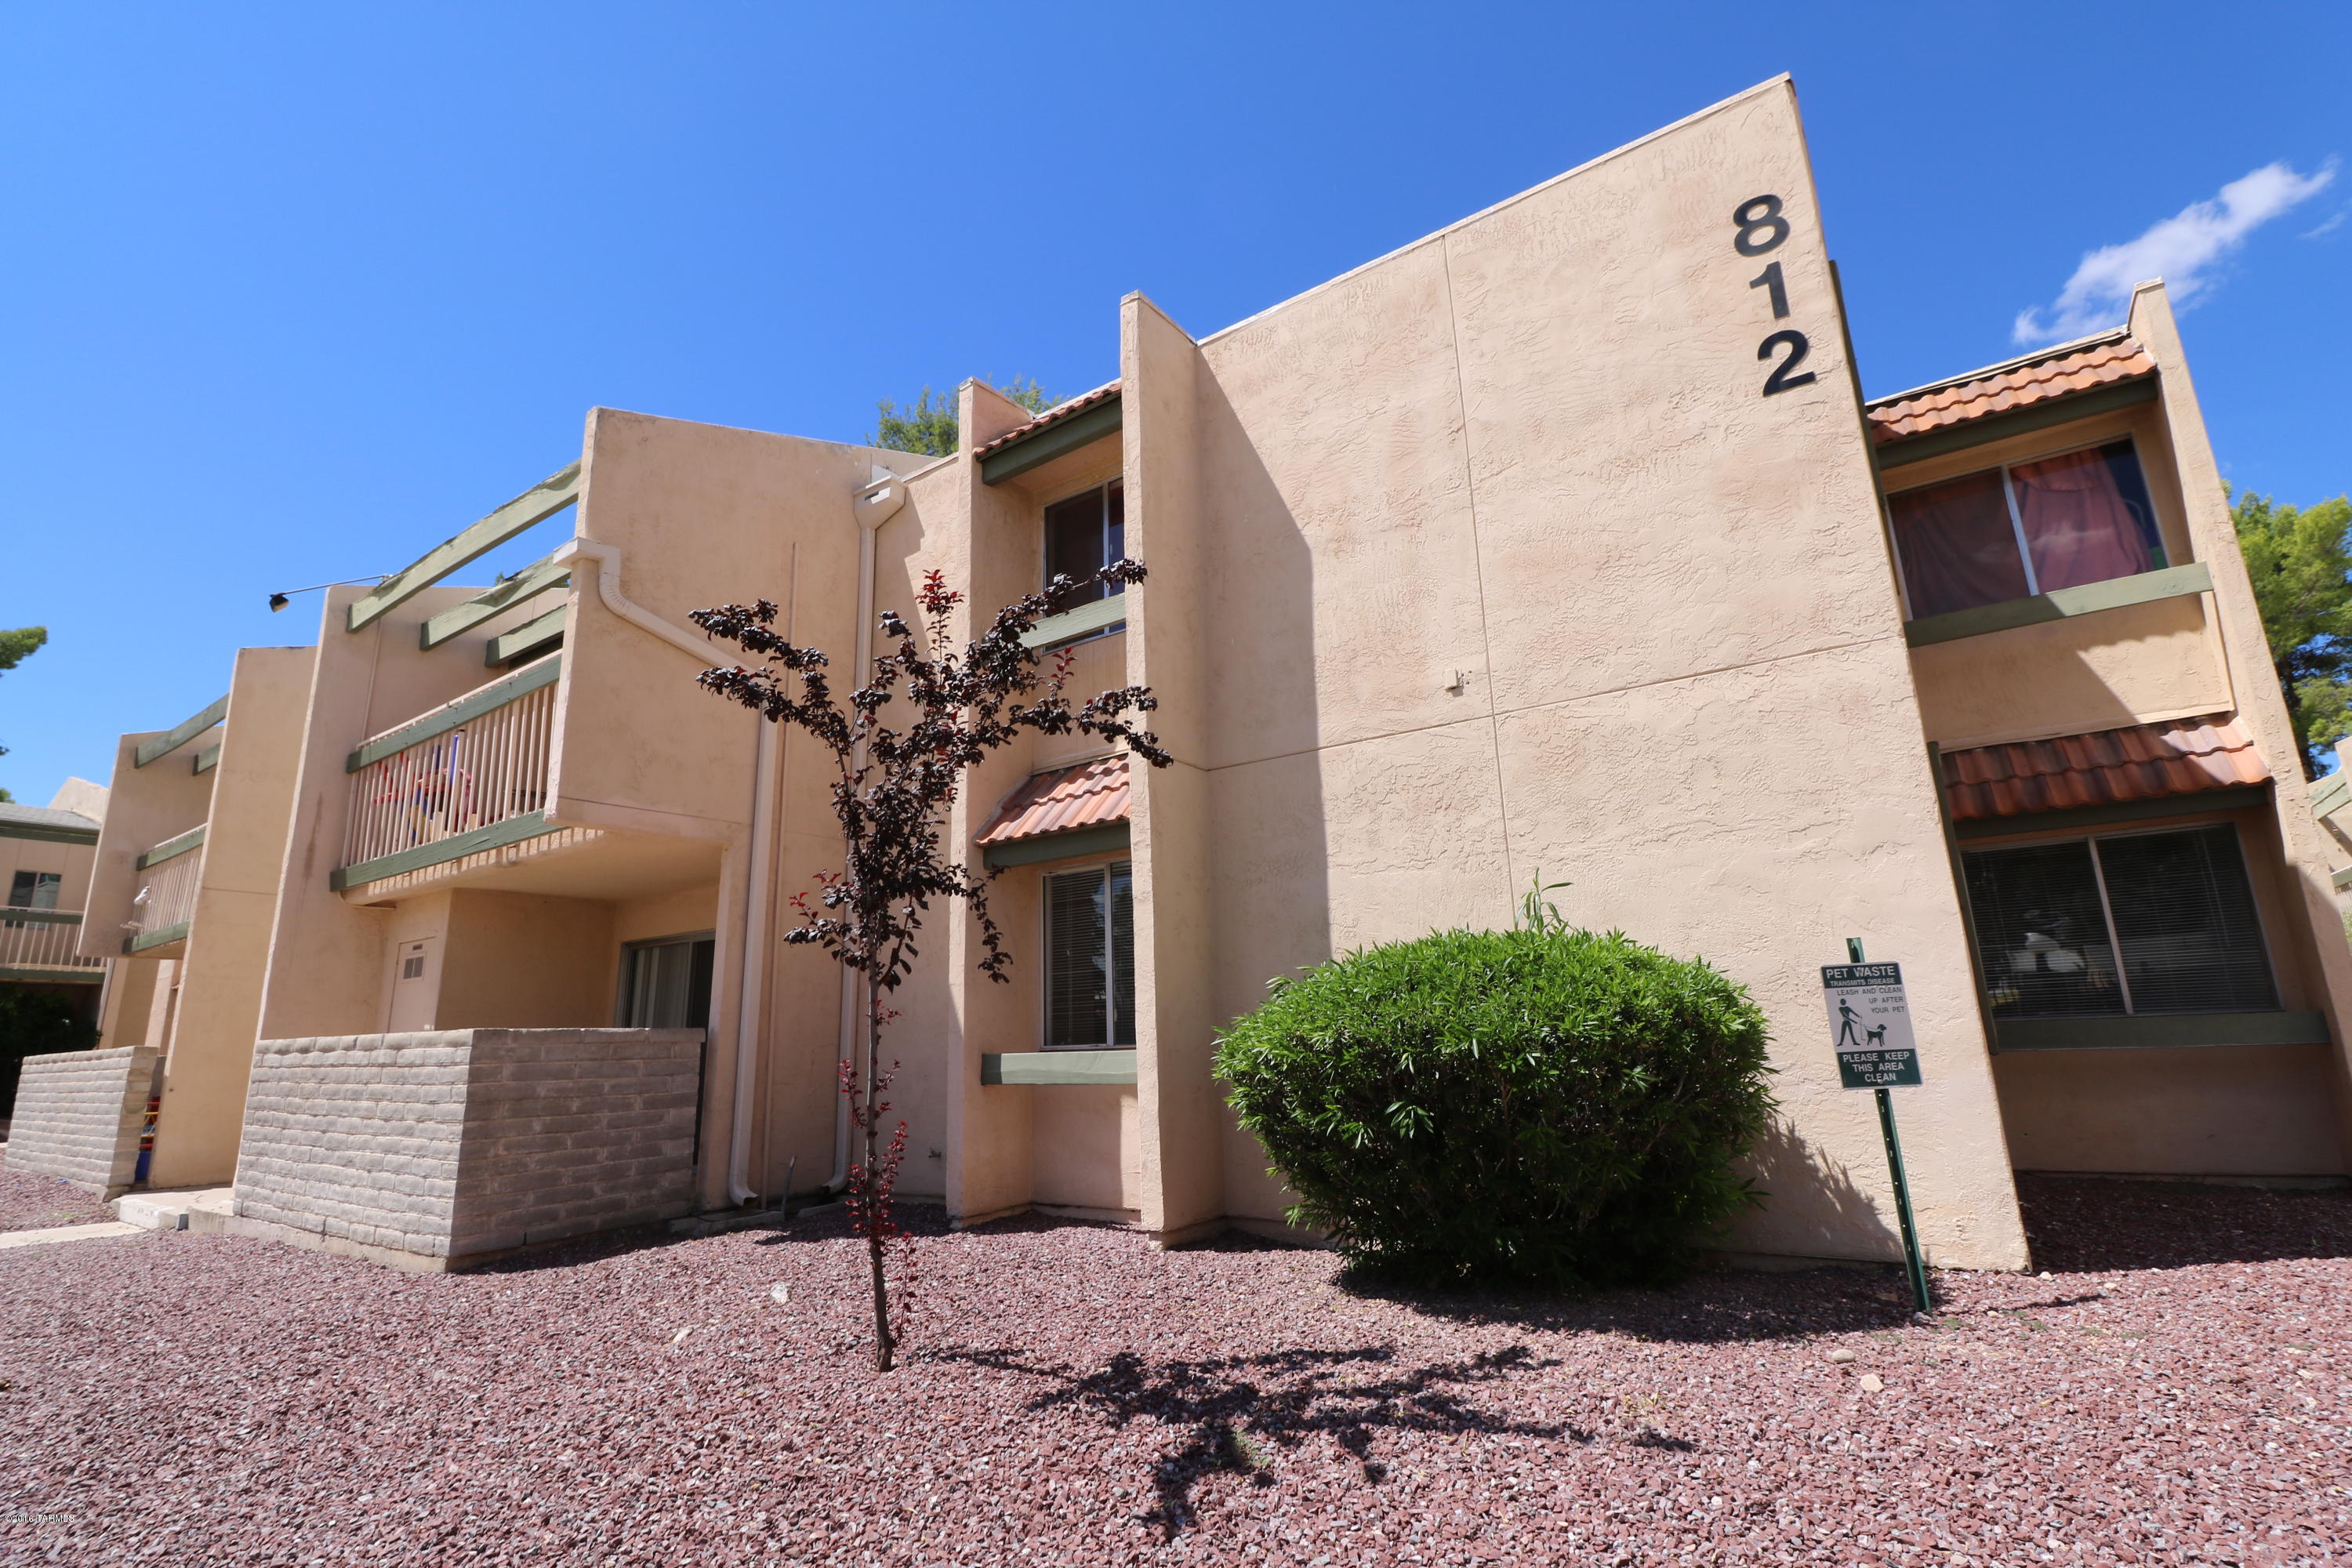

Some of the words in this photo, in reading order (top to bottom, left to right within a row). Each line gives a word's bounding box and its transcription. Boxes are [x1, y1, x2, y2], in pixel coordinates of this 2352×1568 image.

[1826, 968, 1848, 979] PET
[1853, 966, 1896, 978] WASTE
[1830, 979, 1866, 988] TRANSMITS
[1842, 1053, 1878, 1063] PLEASE
[1885, 1051, 1910, 1060] KEEP
[1853, 1063, 1874, 1073] THIS
[1878, 1062, 1905, 1071] AREA
[1864, 1073, 1896, 1082] CLEAN
